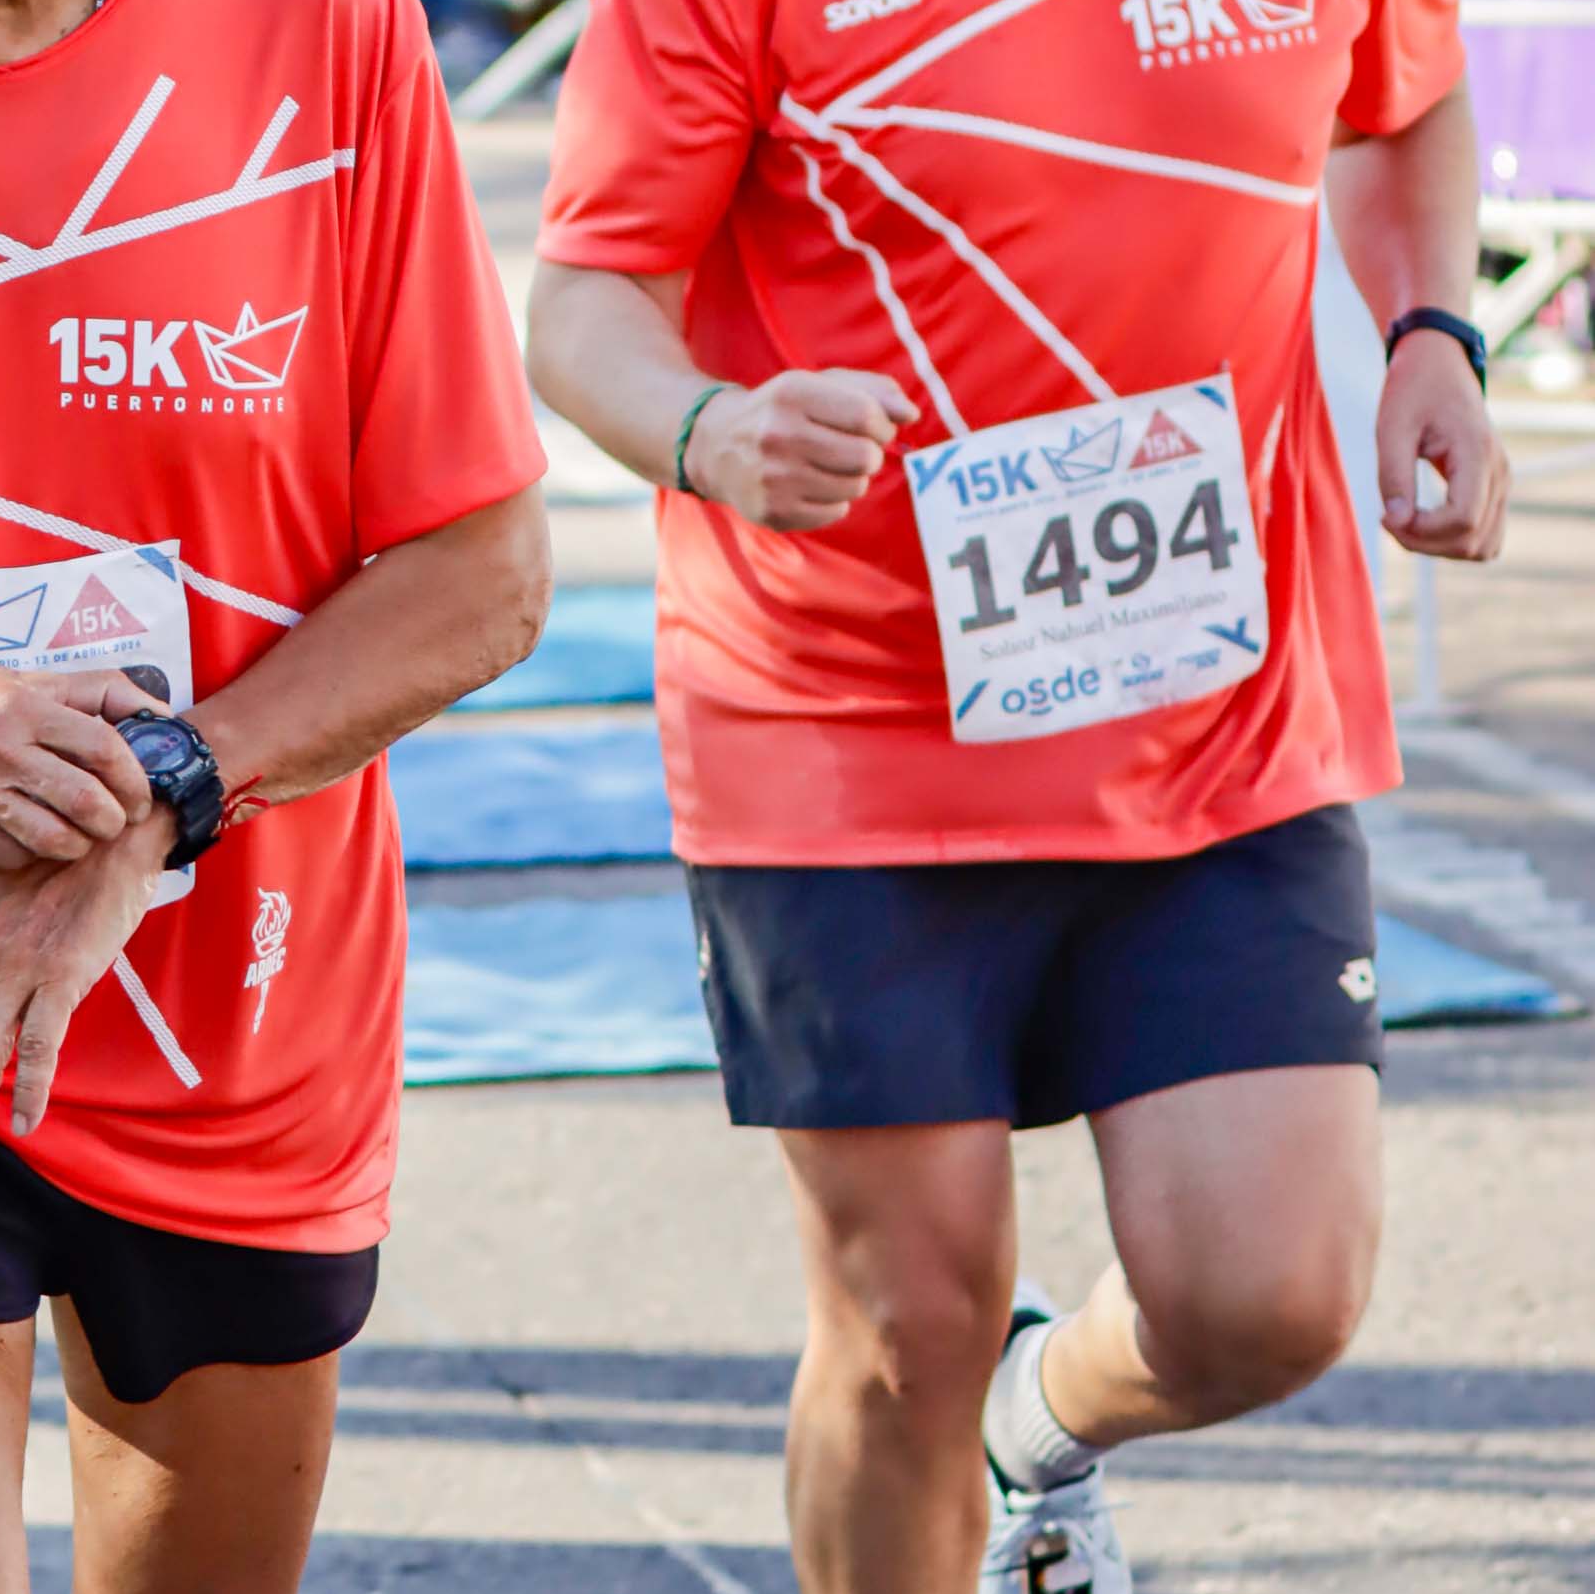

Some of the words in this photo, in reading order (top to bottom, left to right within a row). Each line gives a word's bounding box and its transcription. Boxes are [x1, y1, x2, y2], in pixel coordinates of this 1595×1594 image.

[49, 318, 188, 387] 15K
[60, 392, 186, 413] PUERTO
[201, 397, 284, 413] NORTE
[947, 450, 1038, 506] 15K
[948, 479, 1238, 633] 1494
[70, 601, 121, 636] 15K
[54, 653, 69, 662] DE
[74, 648, 108, 660] ABRIL
[1001, 664, 1100, 715] osde
